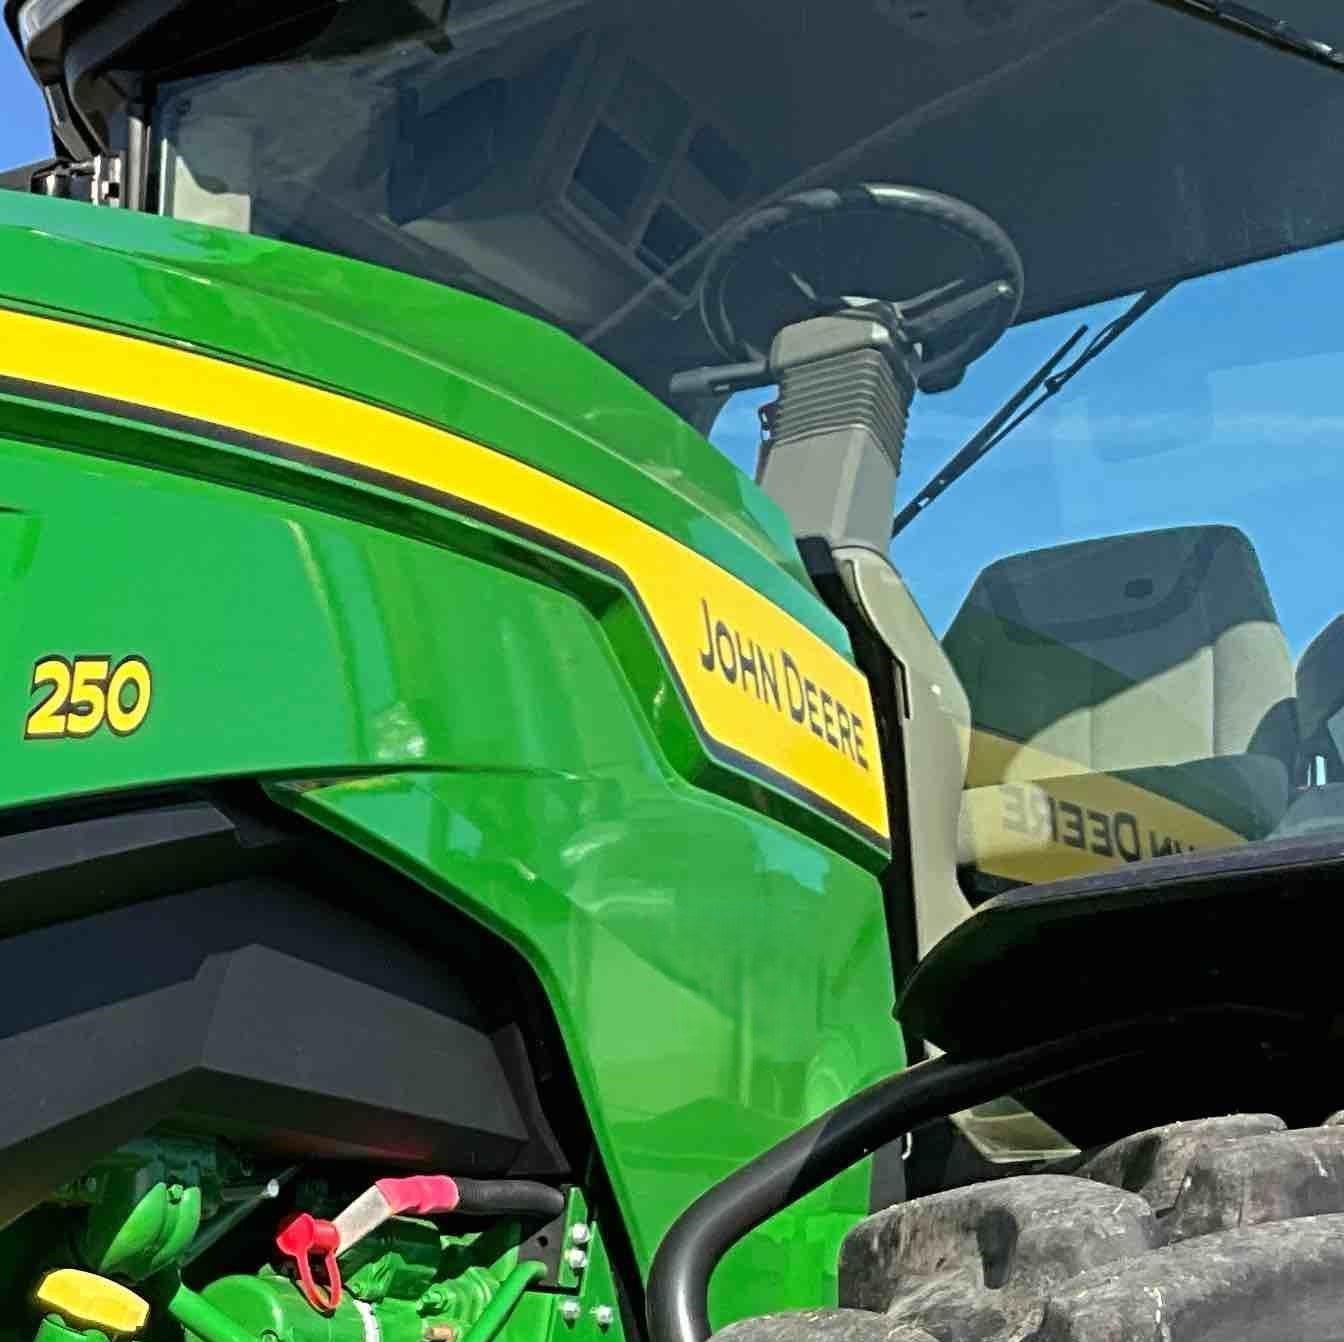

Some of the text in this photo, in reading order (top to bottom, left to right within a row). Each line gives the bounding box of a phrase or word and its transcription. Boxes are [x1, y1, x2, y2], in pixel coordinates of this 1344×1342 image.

[24, 654, 153, 740] 250
[699, 597, 870, 772] JOHN DEERE
